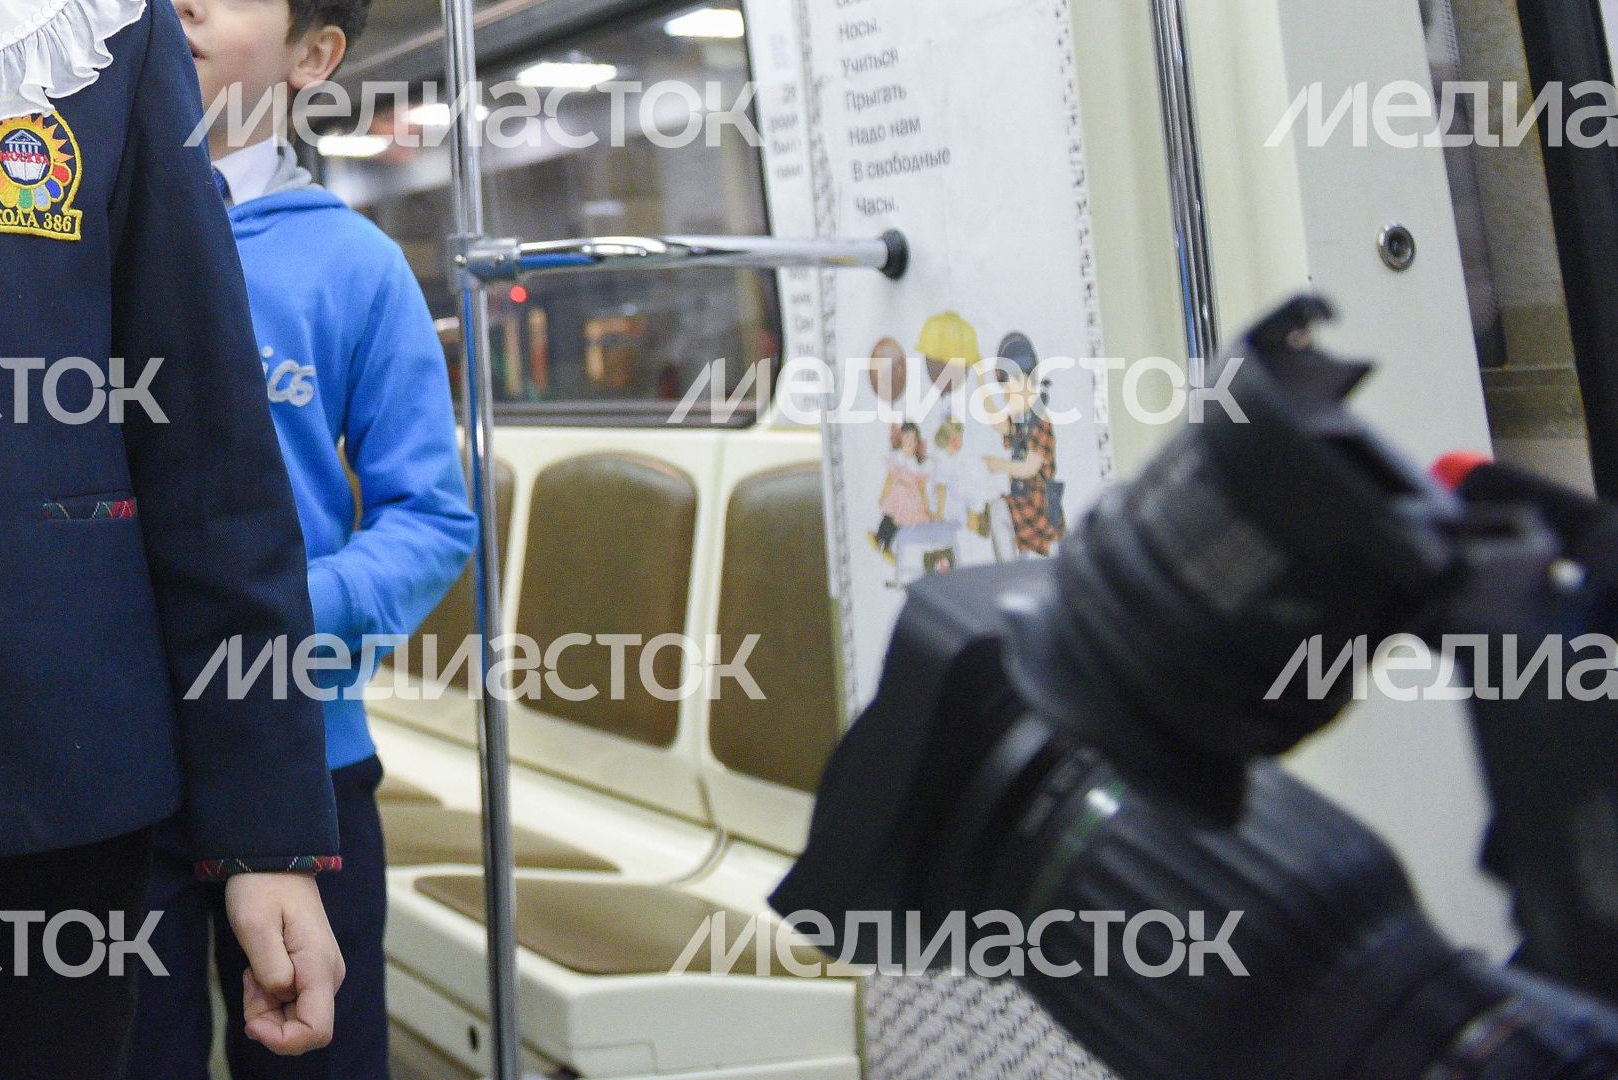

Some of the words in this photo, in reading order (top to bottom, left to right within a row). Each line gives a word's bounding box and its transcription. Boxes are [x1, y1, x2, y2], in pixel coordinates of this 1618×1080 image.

[845, 83, 908, 114] Прыгать
[848, 125, 886, 146] Надо
[890, 116, 922, 138] нам
[867, 147, 952, 180] свободные
[43, 212, 72, 232] 386
